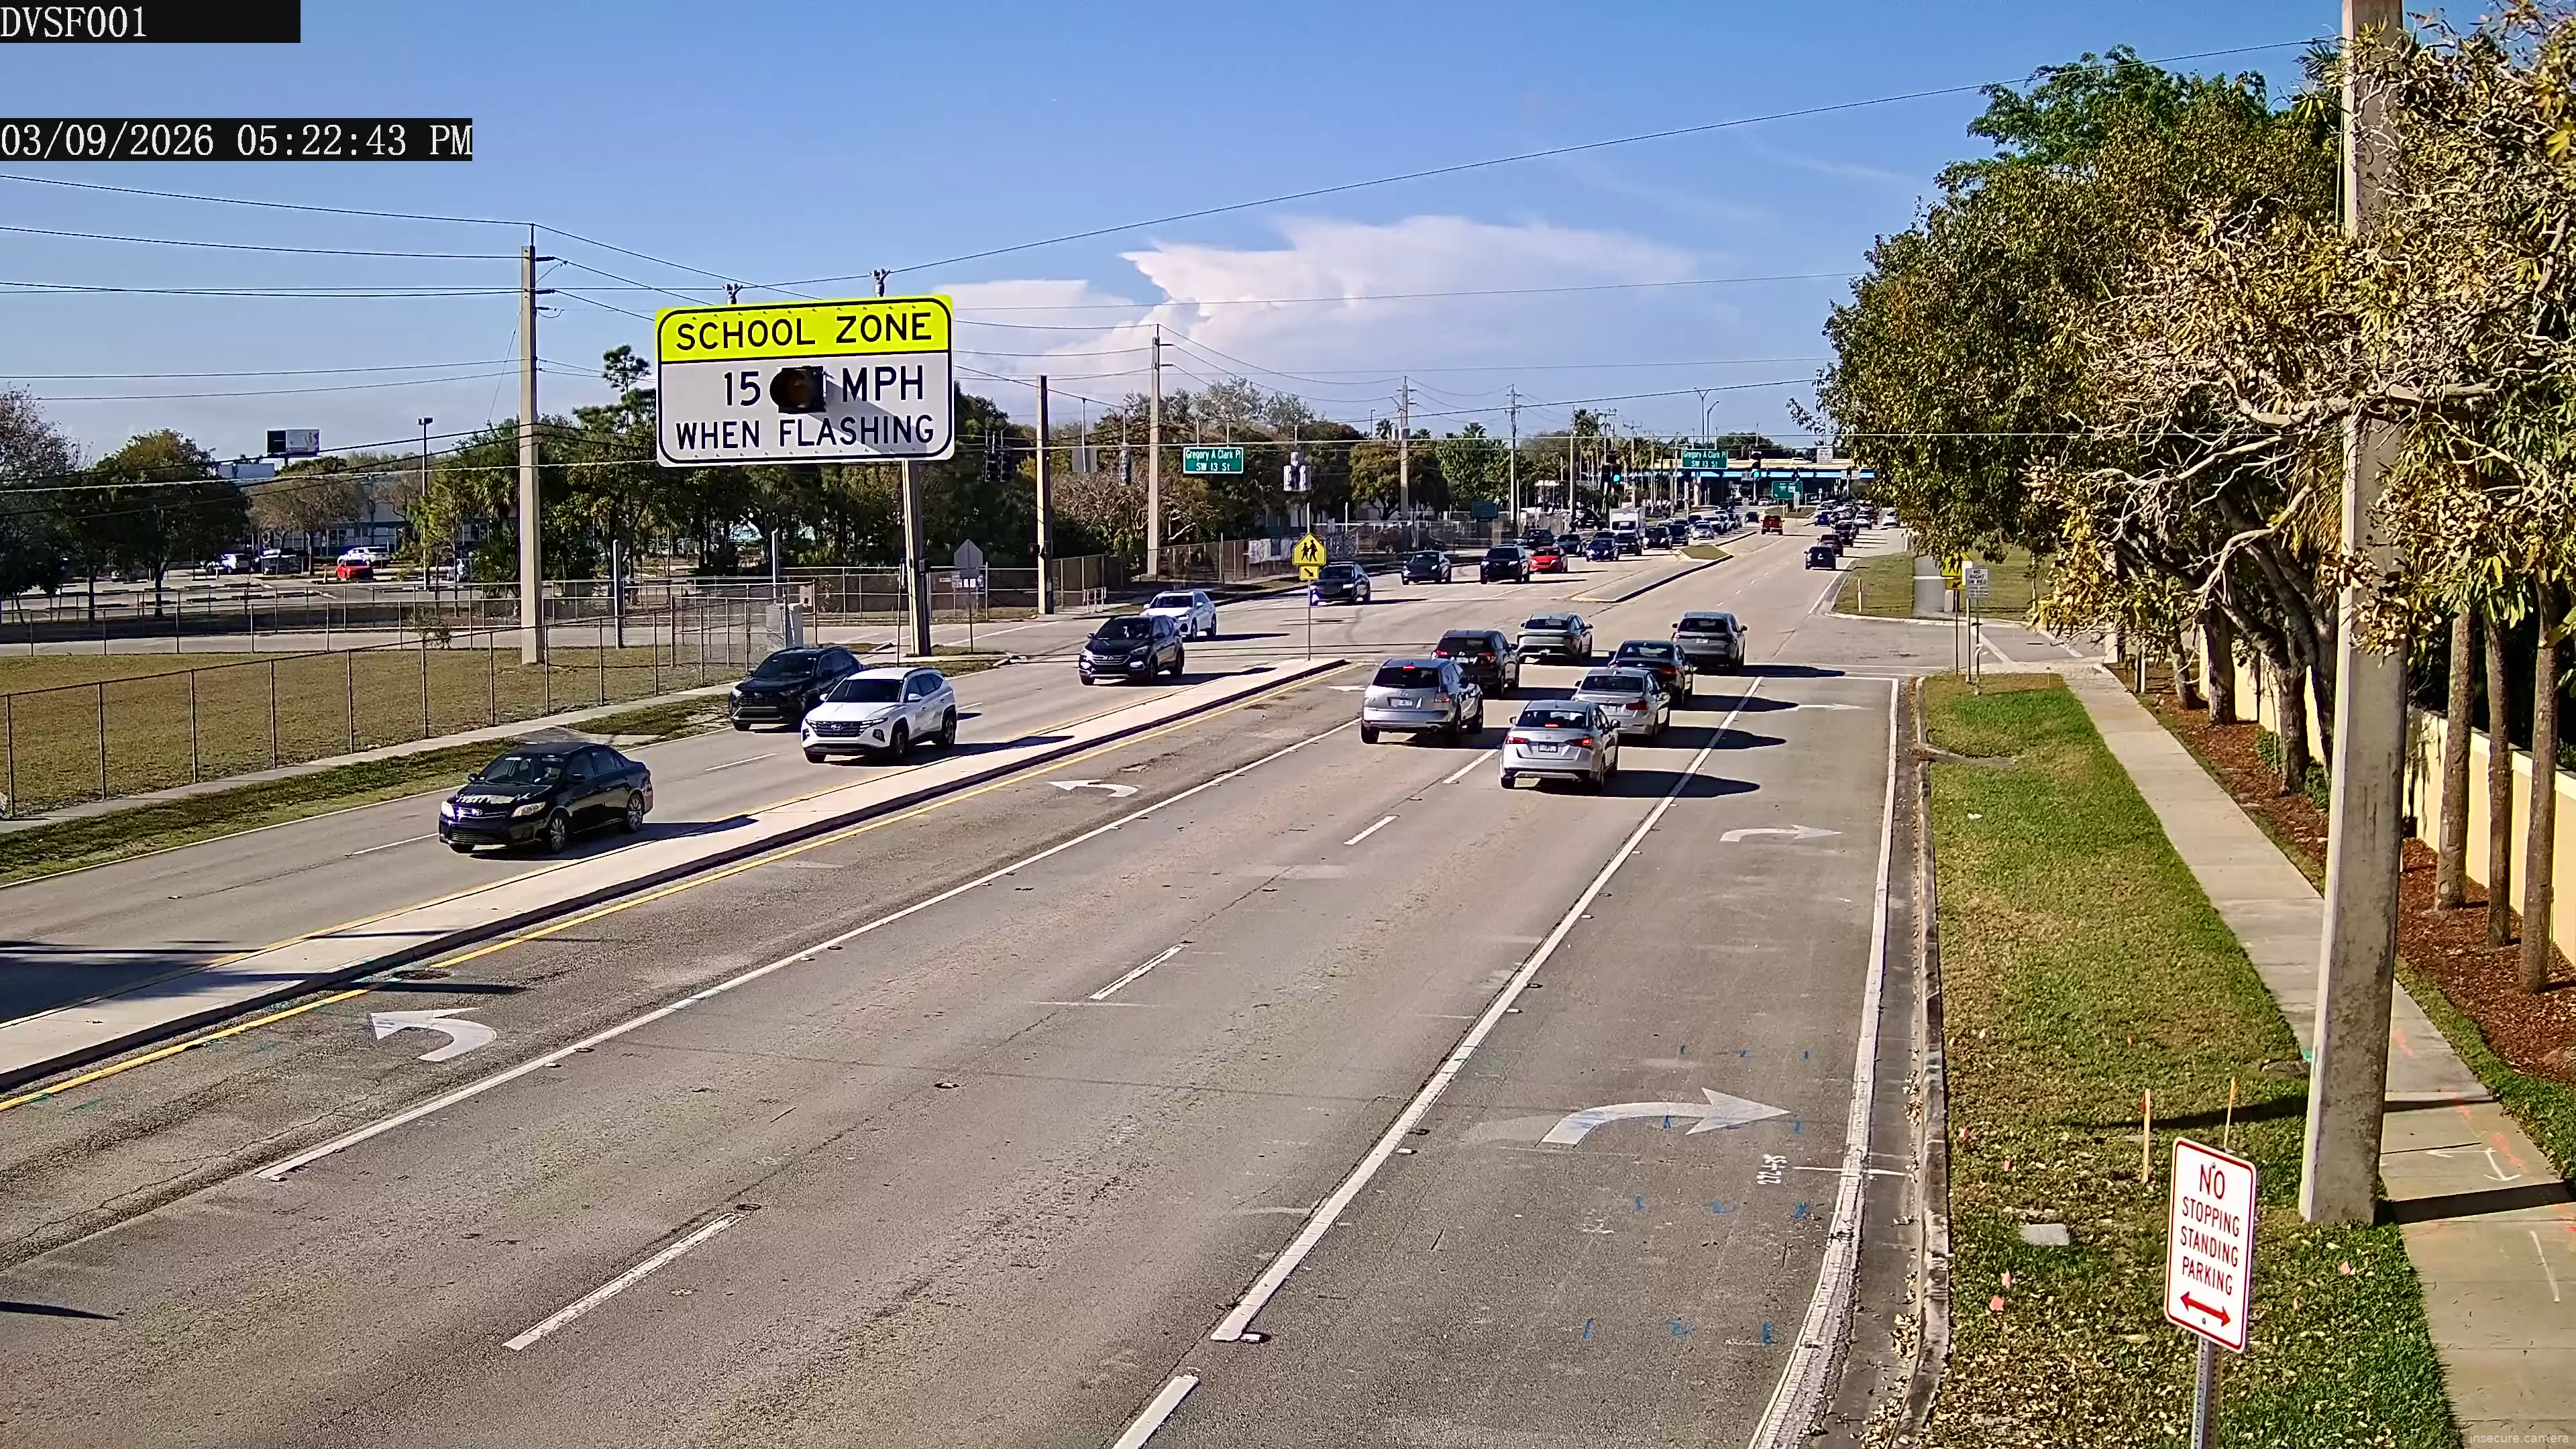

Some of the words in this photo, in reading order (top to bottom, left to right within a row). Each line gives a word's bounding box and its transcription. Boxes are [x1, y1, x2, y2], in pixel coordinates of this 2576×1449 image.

[676, 317, 815, 351] SCHOOL
[836, 312, 932, 344] ZONE
[723, 370, 761, 407] 15
[842, 364, 923, 402] MPH
[676, 419, 760, 450] WHEN
[780, 414, 934, 447] FLASHING
[1185, 449, 1210, 462] Gregory
[1211, 449, 1216, 459] A
[1196, 462, 1207, 471] SW
[1210, 462, 1218, 471] 13
[1222, 462, 1230, 471] St
[1703, 450, 1707, 458] A
[2199, 1164, 2225, 1199] NO
[2182, 1196, 2240, 1238] STOPPING
[2180, 1226, 2239, 1267] STANDING
[2182, 1256, 2233, 1296] PARKING
